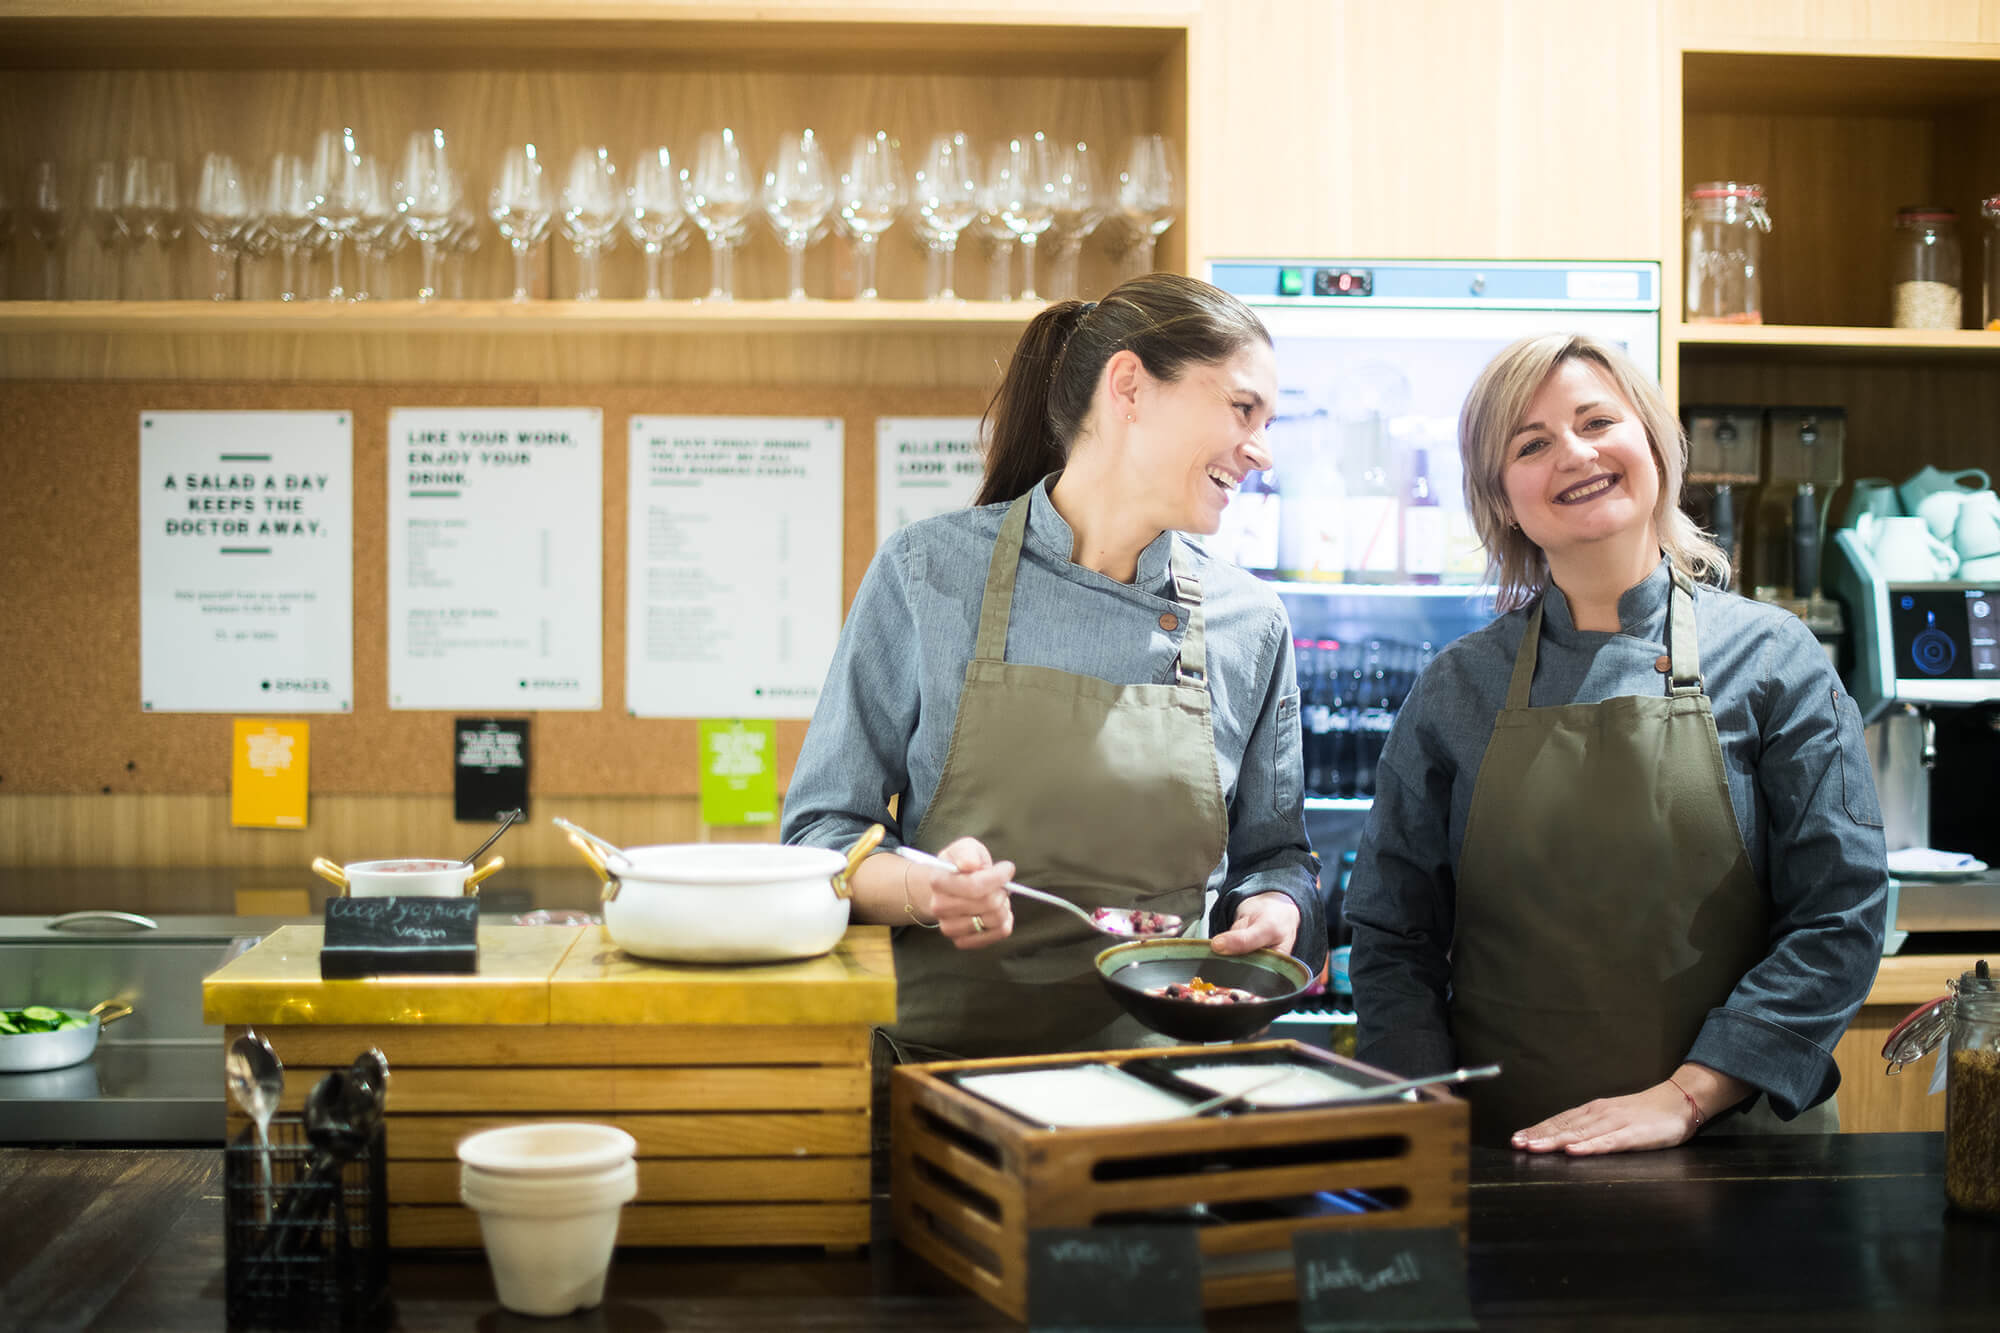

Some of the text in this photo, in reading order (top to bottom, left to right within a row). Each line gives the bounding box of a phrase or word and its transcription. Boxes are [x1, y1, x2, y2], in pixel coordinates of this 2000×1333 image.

[408, 431, 448, 445] LIKE
[456, 431, 508, 444] YOUR
[408, 452, 531, 465] ENJOY YOUR
[898, 461, 946, 475] LOOK
[164, 474, 327, 490] A SALAD A DAY
[188, 497, 304, 512] KEEPS THE
[166, 519, 249, 535] DOCTOR
